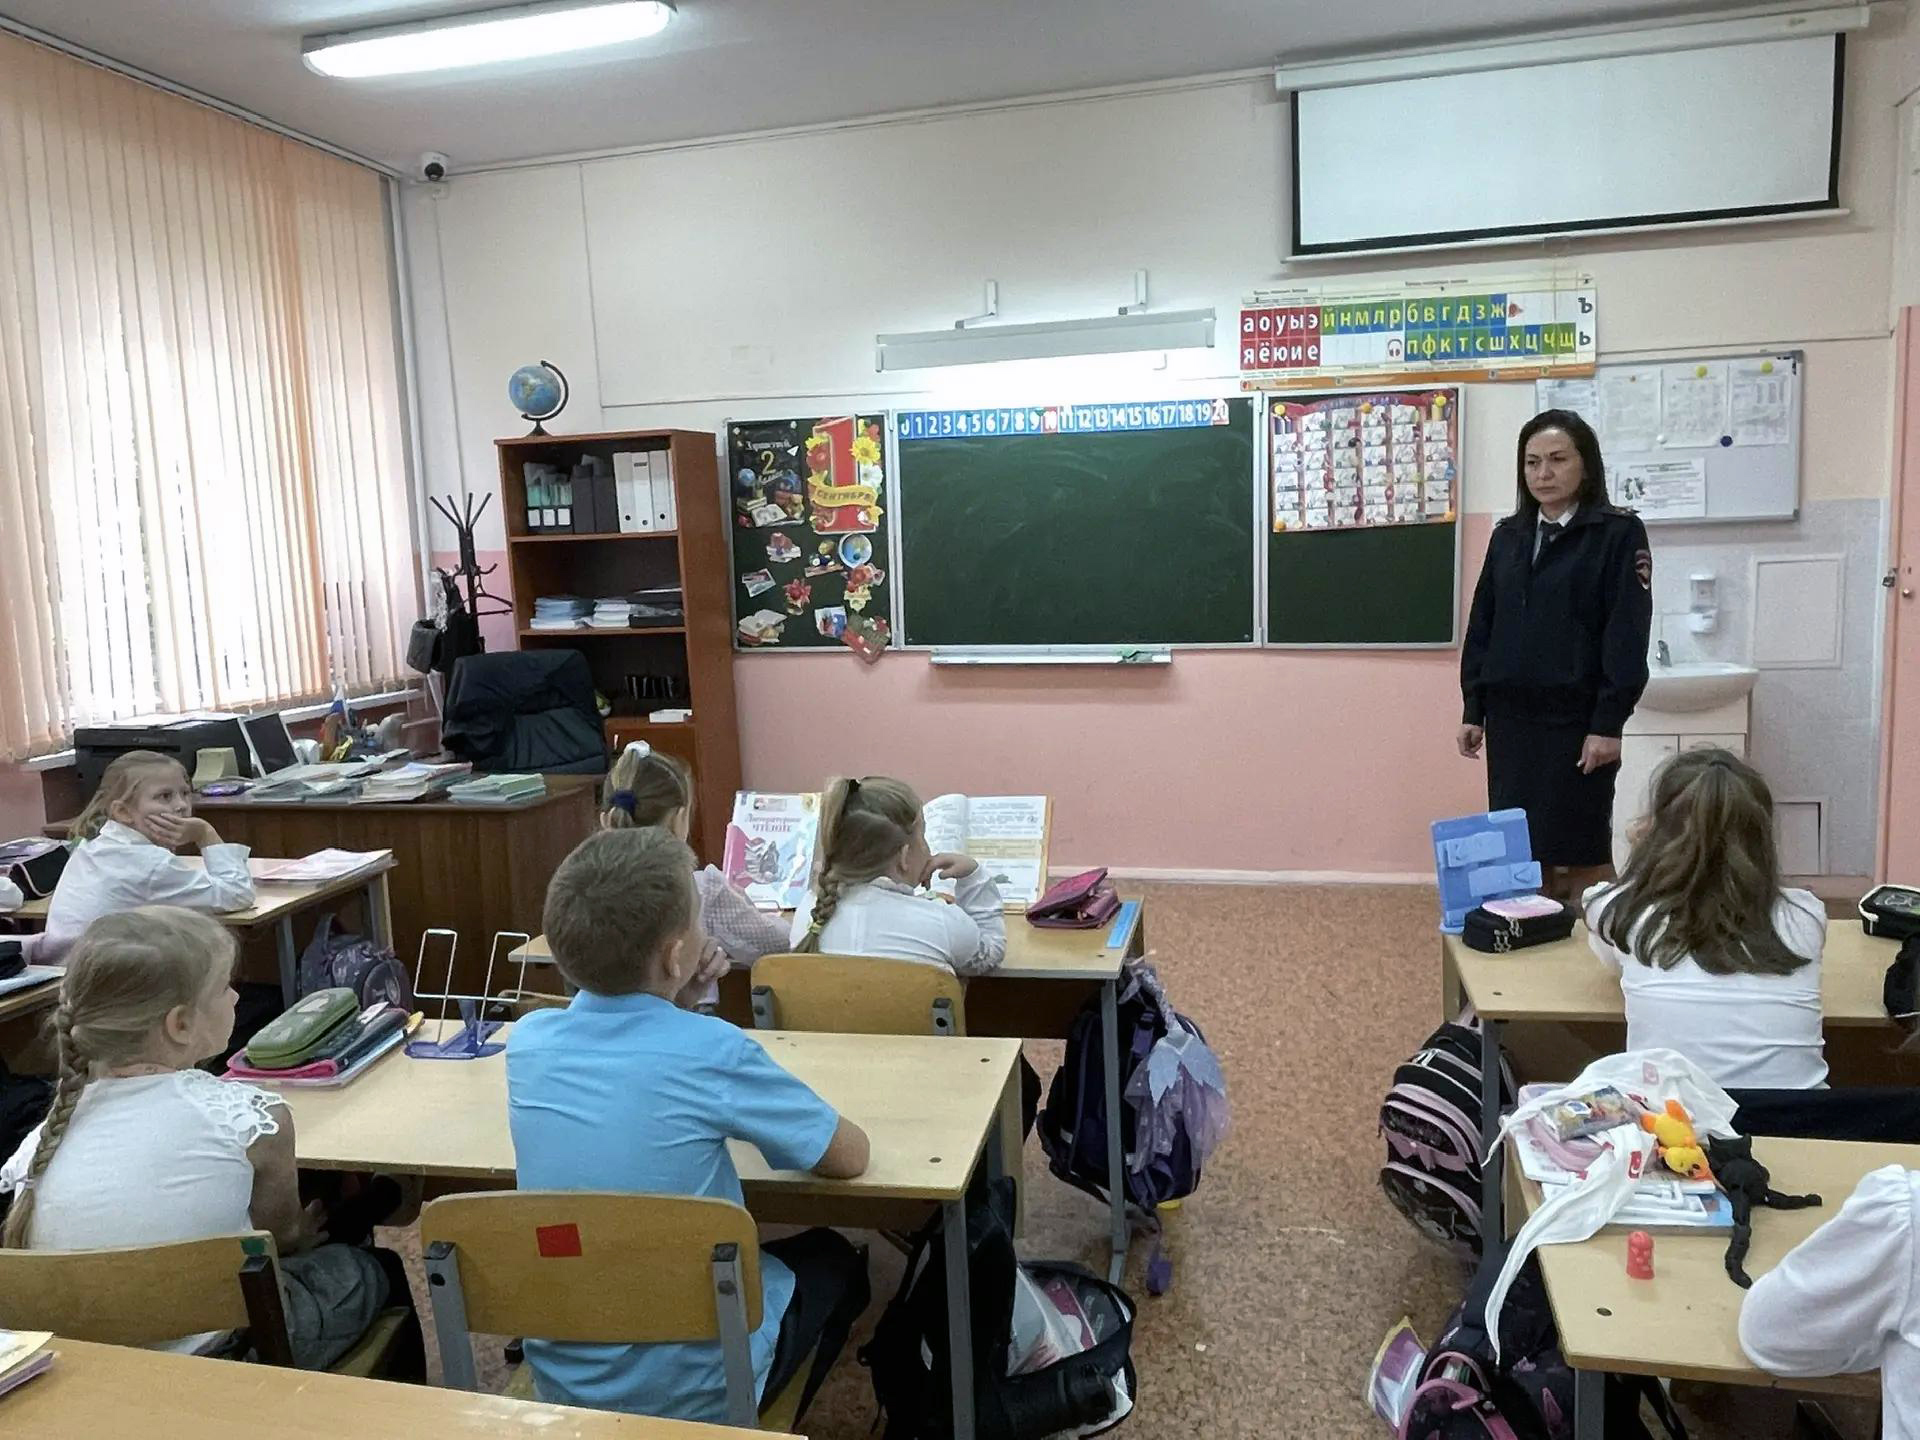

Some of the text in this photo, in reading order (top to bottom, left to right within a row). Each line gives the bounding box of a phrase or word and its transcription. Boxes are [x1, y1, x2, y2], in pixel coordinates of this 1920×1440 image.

[915, 416, 922, 434] 1
[929, 415, 937, 434] 2
[943, 415, 951, 433] 3
[957, 414, 967, 432] 4
[971, 414, 981, 432] 5
[986, 413, 995, 432] 6
[1000, 412, 1009, 431] 7
[1015, 412, 1024, 431] 8
[1030, 412, 1040, 430] 9
[1077, 409, 1092, 428] 12
[1094, 409, 1108, 428] 13
[1111, 408, 1125, 427] 14
[1127, 407, 1142, 426] 15
[1144, 406, 1159, 425] 16
[1161, 405, 1176, 424] 17
[1179, 404, 1194, 422] 18
[1195, 404, 1210, 422] 19
[761, 450, 777, 475] 2
